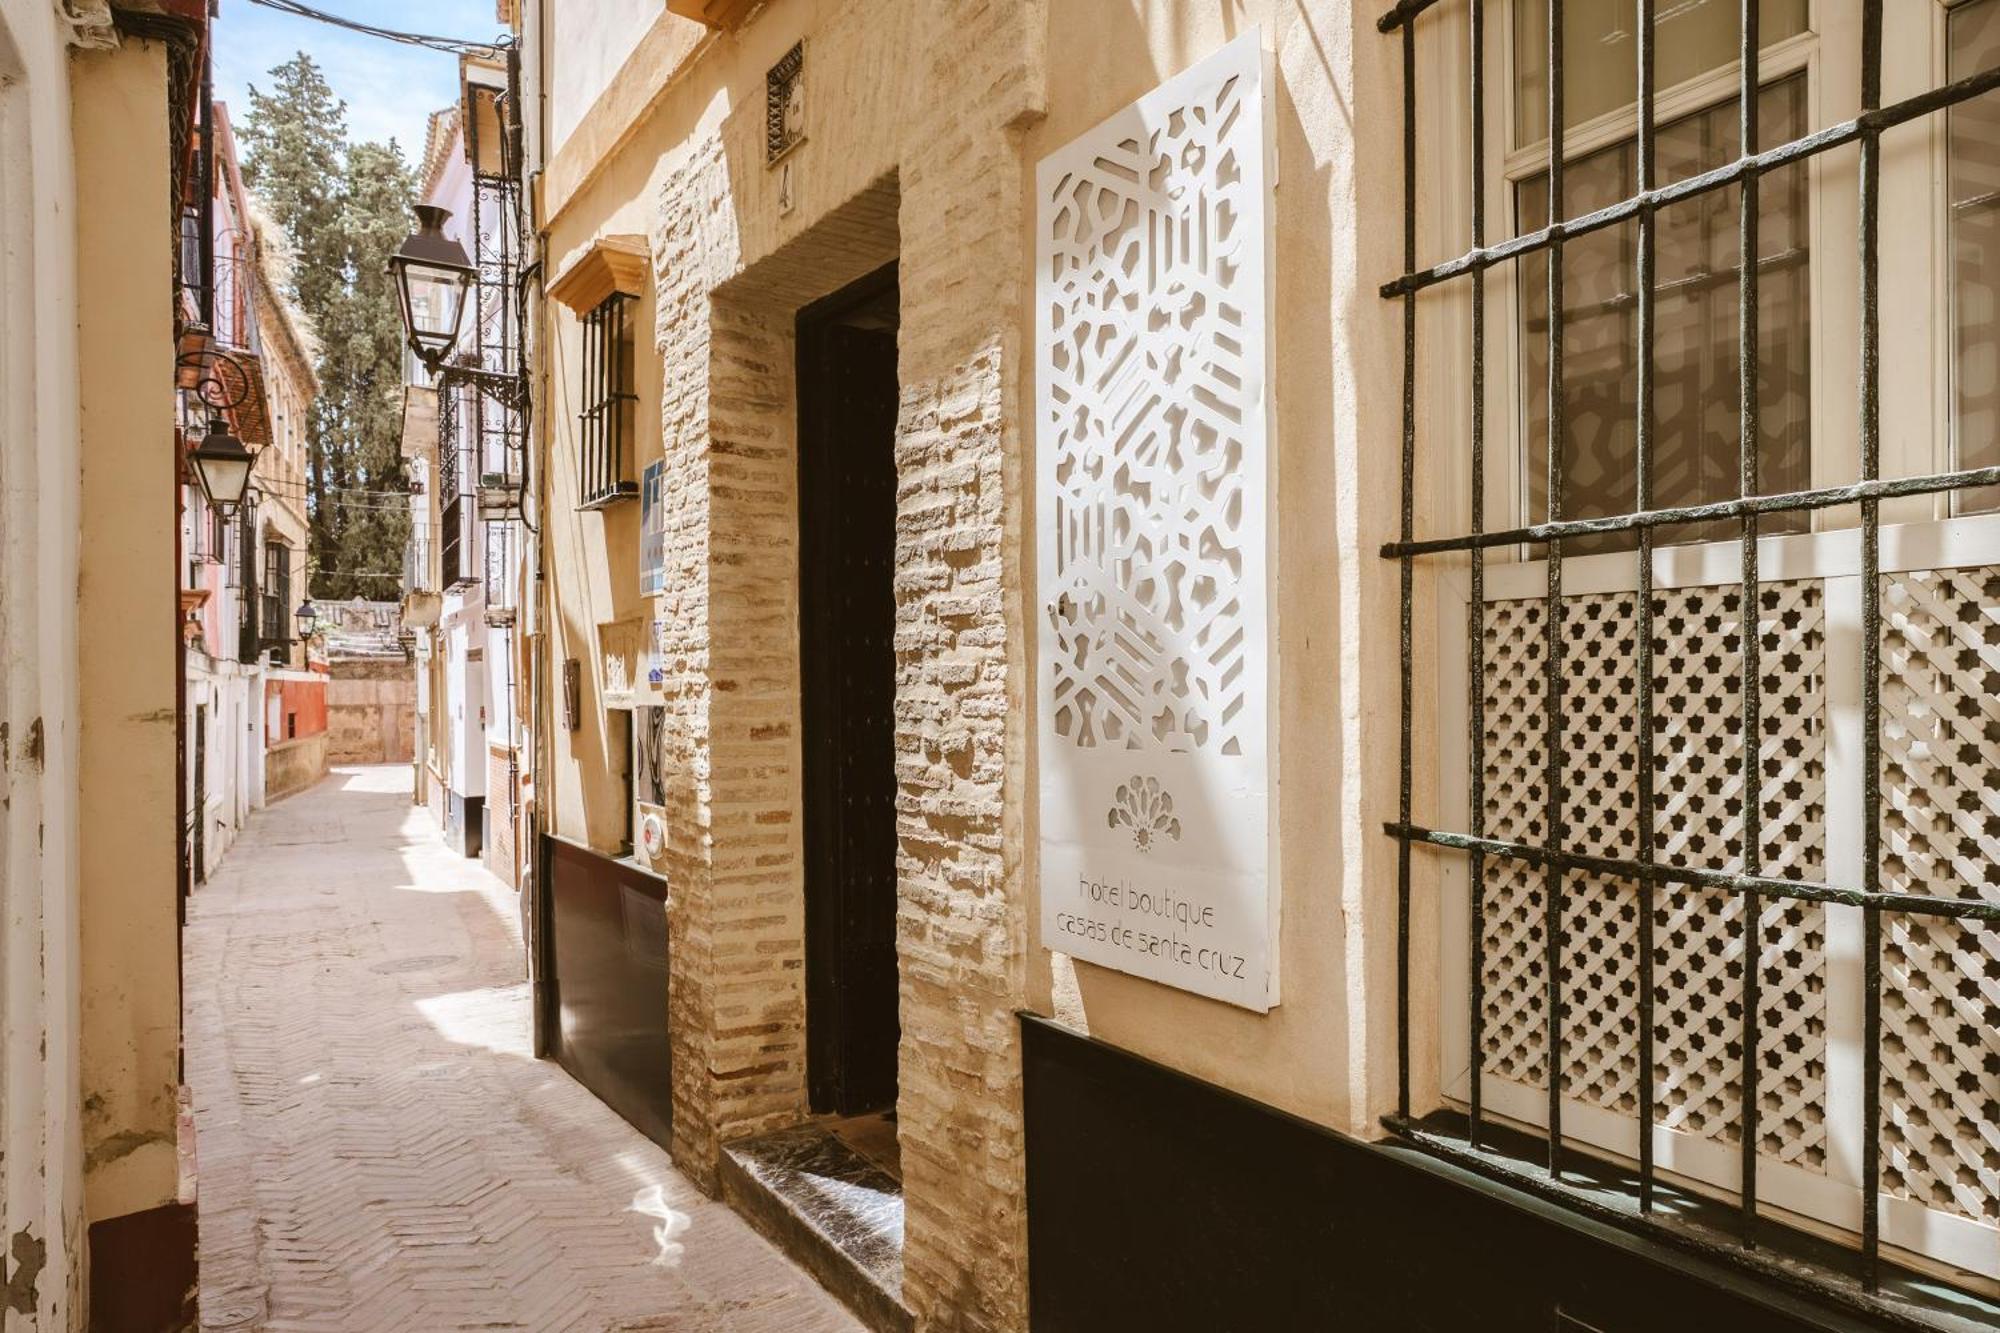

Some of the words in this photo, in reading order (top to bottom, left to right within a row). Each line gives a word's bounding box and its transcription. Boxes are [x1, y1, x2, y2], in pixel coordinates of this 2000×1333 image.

[1079, 873, 1124, 907] hotel
[1128, 879, 1215, 932] boutique
[1056, 912, 1106, 942] casas
[1111, 919, 1132, 949] de
[1138, 931, 1192, 965] santa
[1198, 948, 1245, 980] cruz
